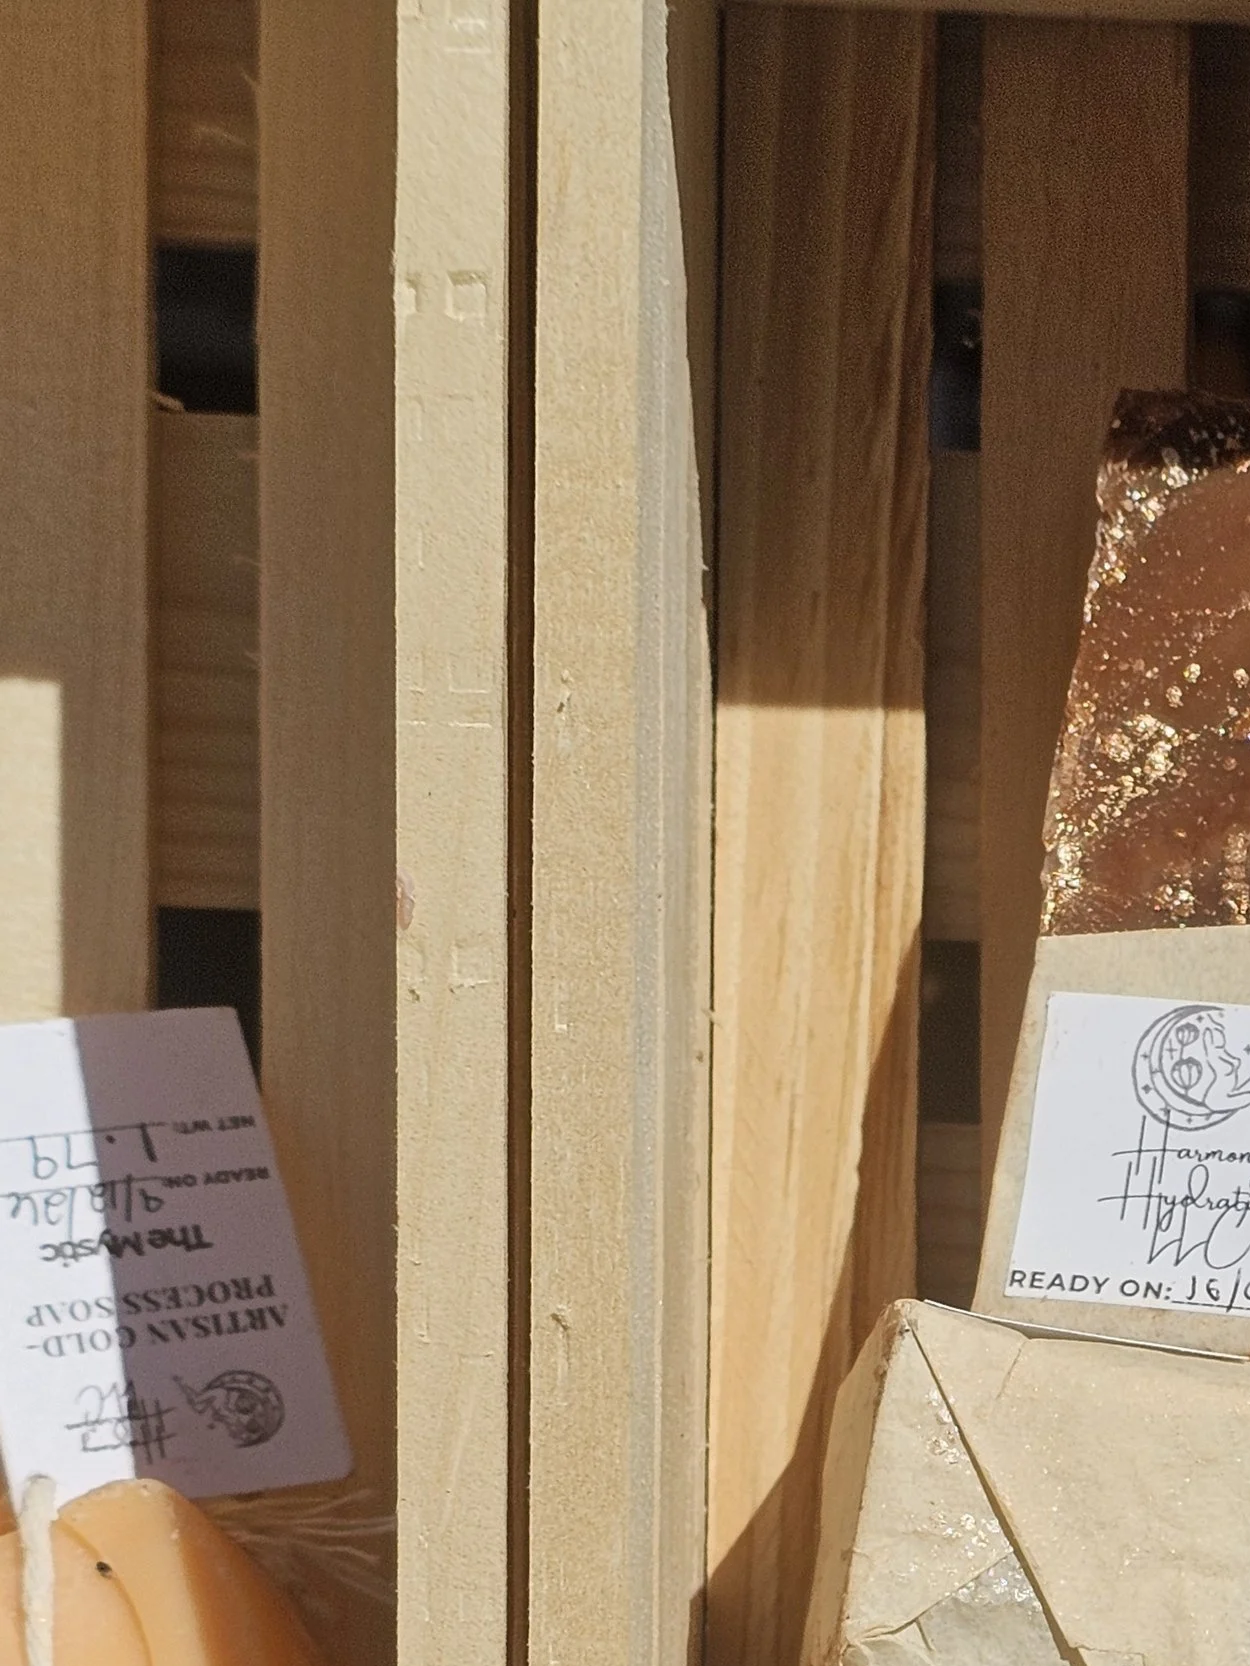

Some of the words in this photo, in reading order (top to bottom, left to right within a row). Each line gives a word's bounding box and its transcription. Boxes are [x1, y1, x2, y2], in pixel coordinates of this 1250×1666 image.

[204, 1167, 269, 1185] READY
[39, 1230, 144, 1268] Mystic
[149, 1225, 213, 1252] The
[122, 1274, 275, 1315] PROCESS
[1008, 1270, 1110, 1295] READY
[1120, 1279, 1173, 1300] ON:
[26, 1297, 114, 1327] SOAP
[147, 1304, 288, 1344] ARTISAN
[25, 1325, 136, 1357] COLD-
